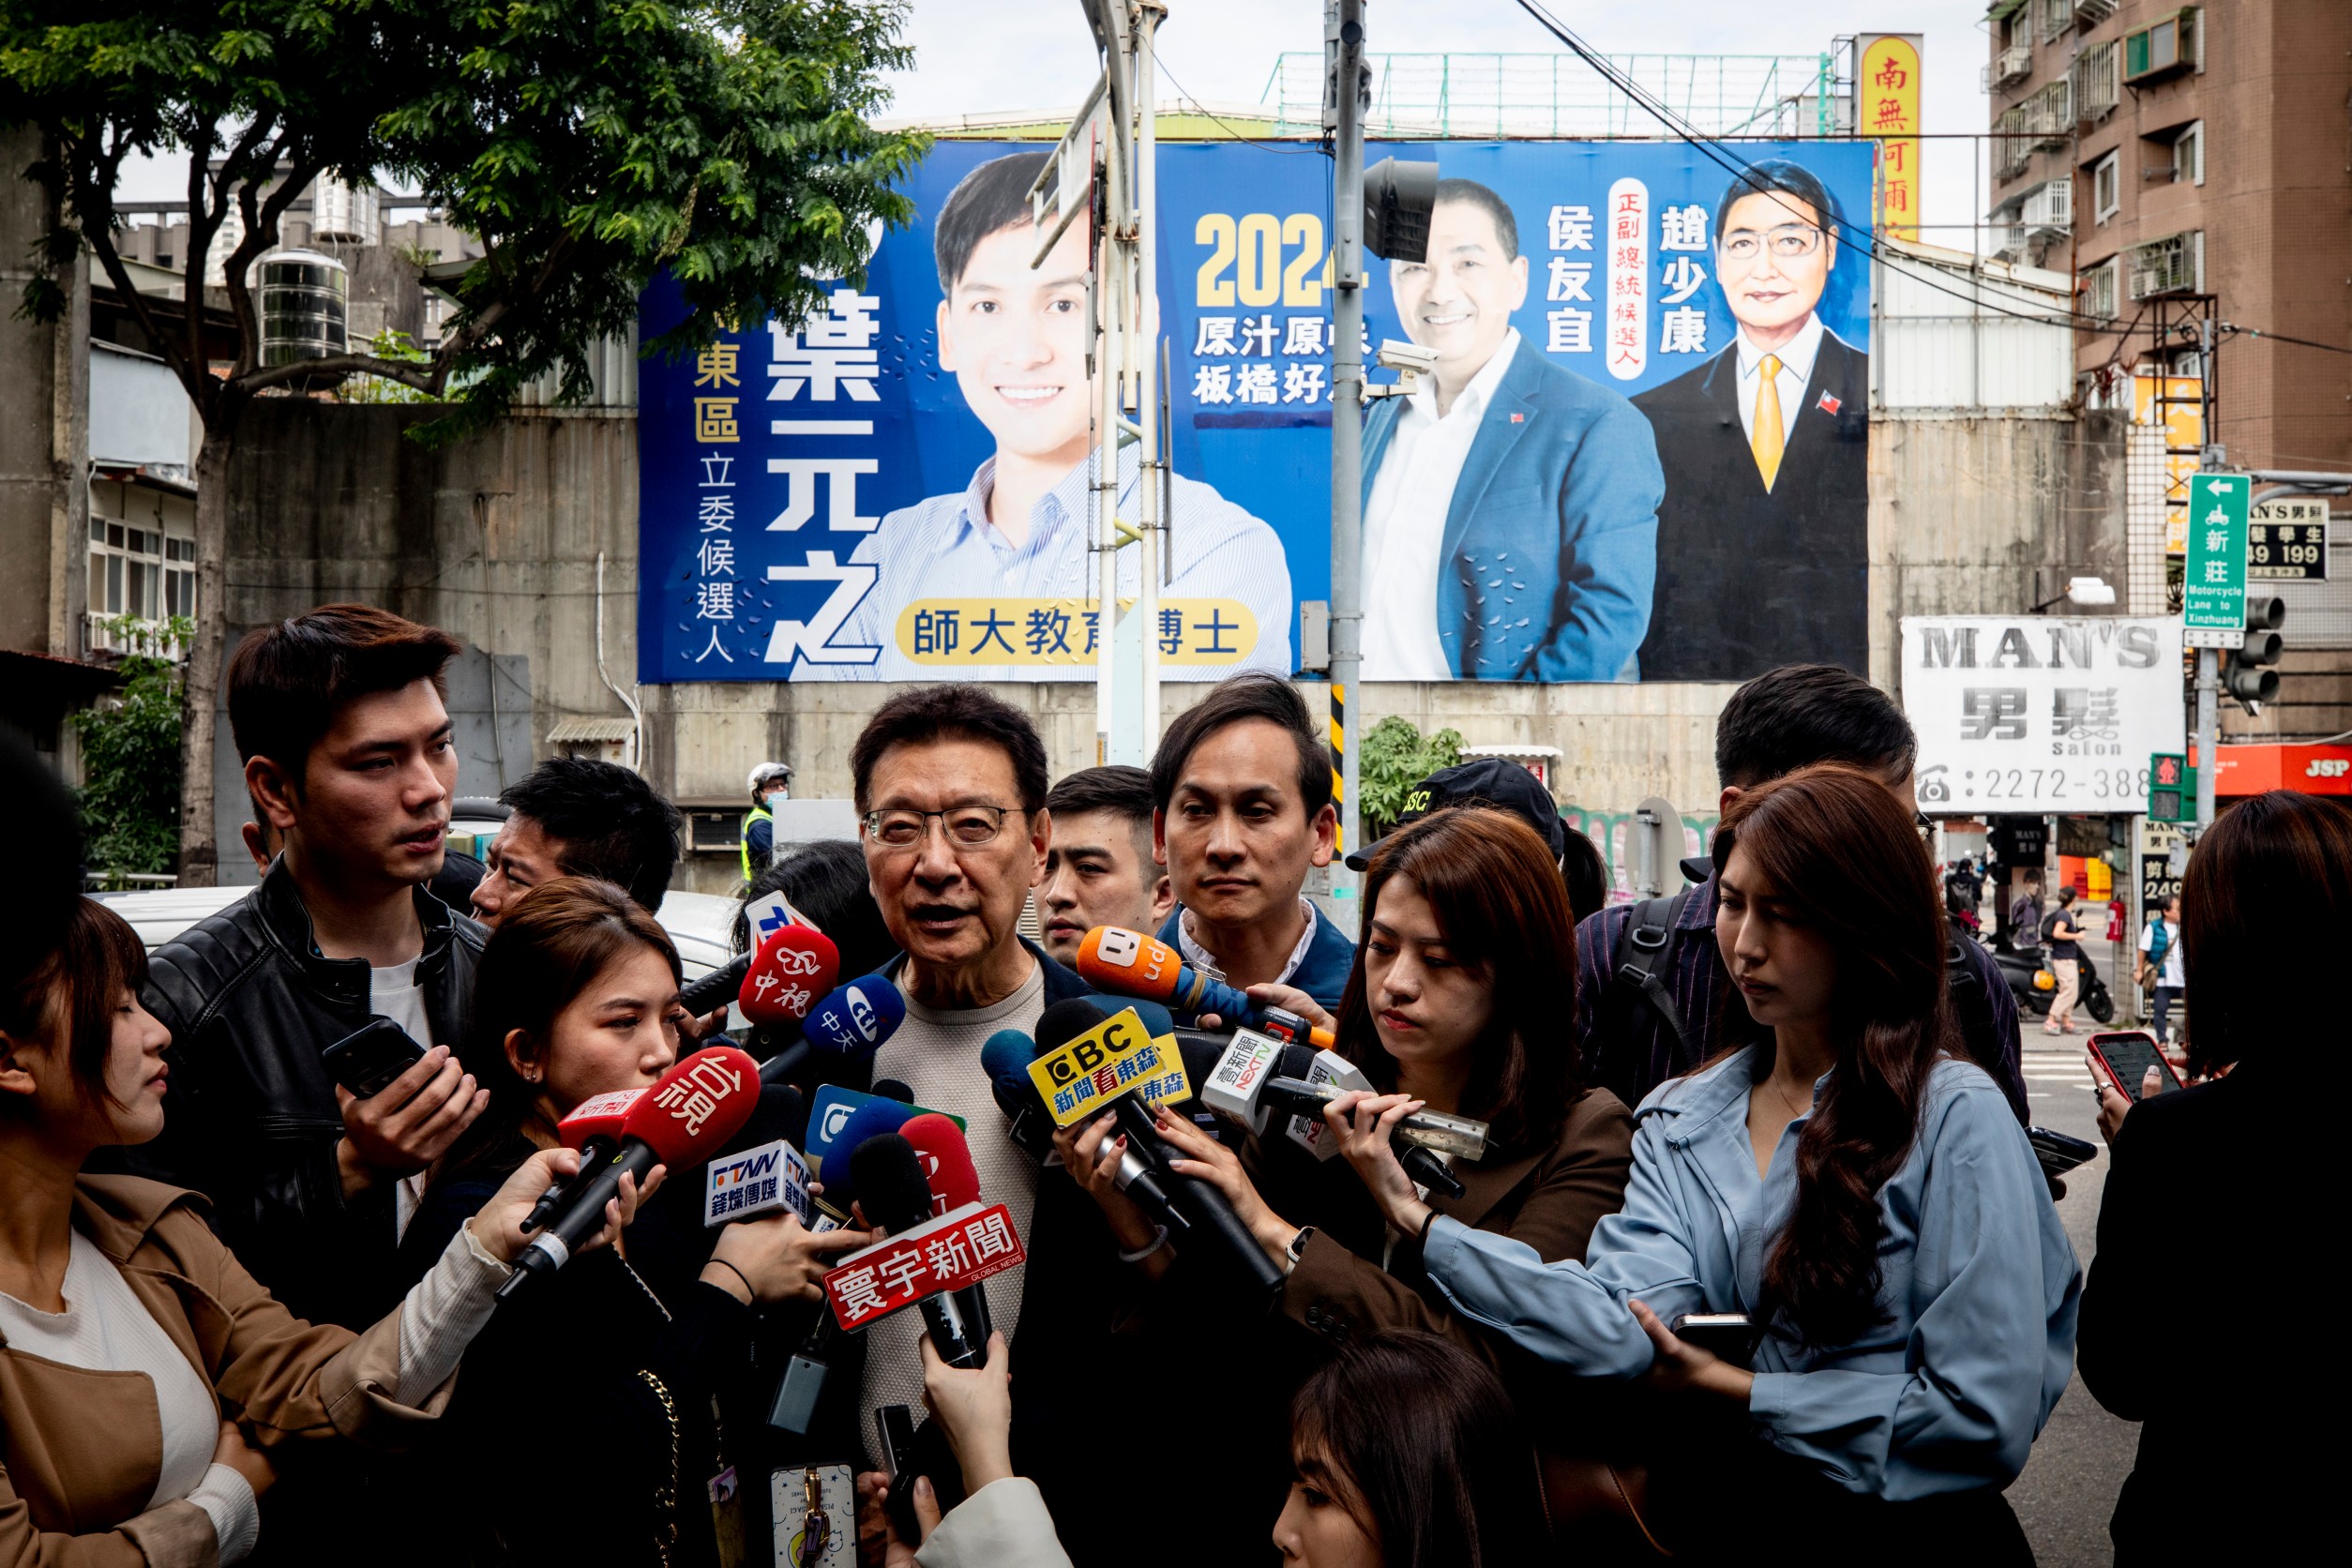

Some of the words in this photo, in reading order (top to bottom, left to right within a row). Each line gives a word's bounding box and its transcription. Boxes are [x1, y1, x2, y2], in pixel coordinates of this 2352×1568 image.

[1873, 57, 1909, 240] 南無阿彌
[1545, 204, 1594, 354] 侯友宜
[1614, 193, 1645, 366] 正副總統候選人
[1659, 204, 1710, 354] 趙少康
[1192, 363, 1371, 405] 板橋好
[765, 289, 882, 665] 葉元之
[2204, 529, 2230, 583] 新莊
[2283, 545, 2319, 564] 199
[2188, 584, 2242, 599] Motorcycle
[2188, 600, 2211, 611] Lane
[2220, 600, 2230, 611] to
[2188, 613, 2240, 627] Xinzhuang
[1920, 626, 2161, 669] MAN'S
[2052, 741, 2121, 756] Salon
[2305, 759, 2350, 777] JSP
[2145, 822, 2174, 832] MAN
[755, 970, 811, 1018] 中視
[822, 1010, 858, 1053] 中天
[1052, 1045, 1159, 1115] 新聞看東森
[1216, 1035, 1259, 1086] 壹新聞
[1136, 1071, 1184, 1103] 東森
[832, 1212, 1014, 1322] 寰宇新聞
[971, 1266, 1001, 1282] GLOBAL
[1000, 1255, 1023, 1270] NEWS
